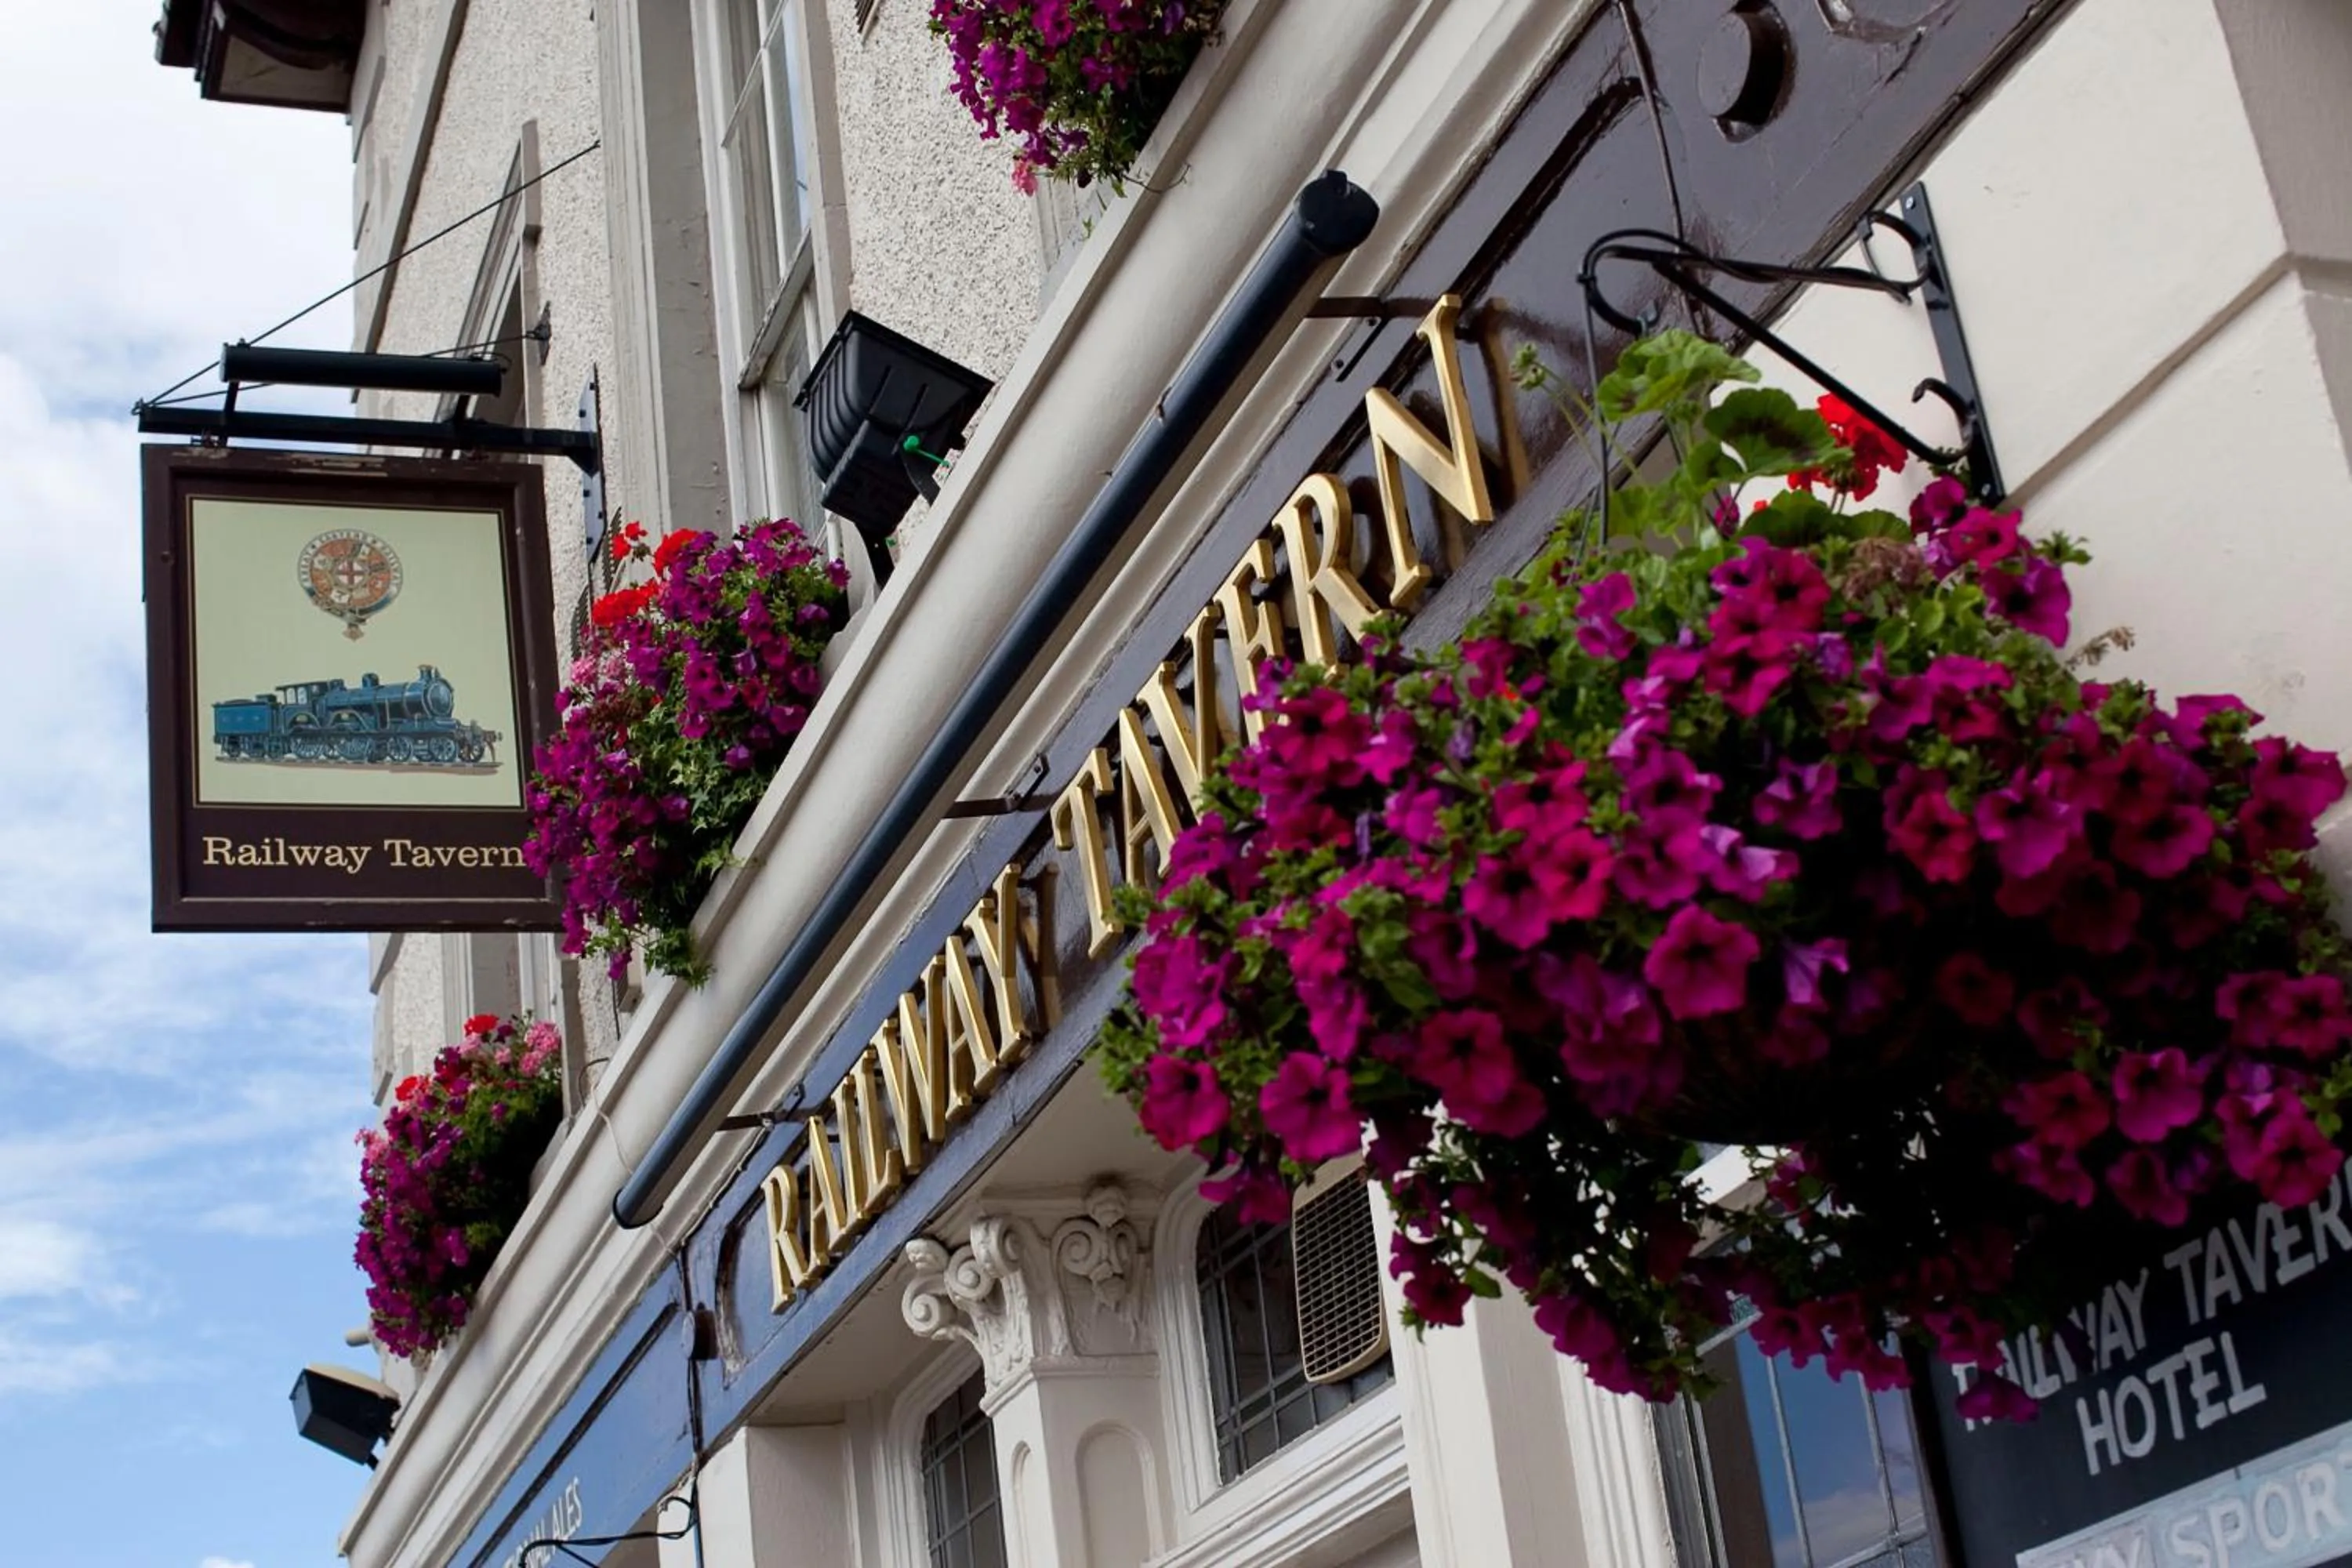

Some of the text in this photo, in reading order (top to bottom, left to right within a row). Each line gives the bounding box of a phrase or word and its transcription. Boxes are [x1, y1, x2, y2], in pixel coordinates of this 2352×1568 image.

[202, 837, 527, 874] Railway Tavern
[760, 293, 1494, 1315] RAILWAY TAVERN
[2076, 1330, 2267, 1476] HOTEL
[552, 1475, 583, 1556] ALES
[2170, 1450, 2352, 1568] SPOR
